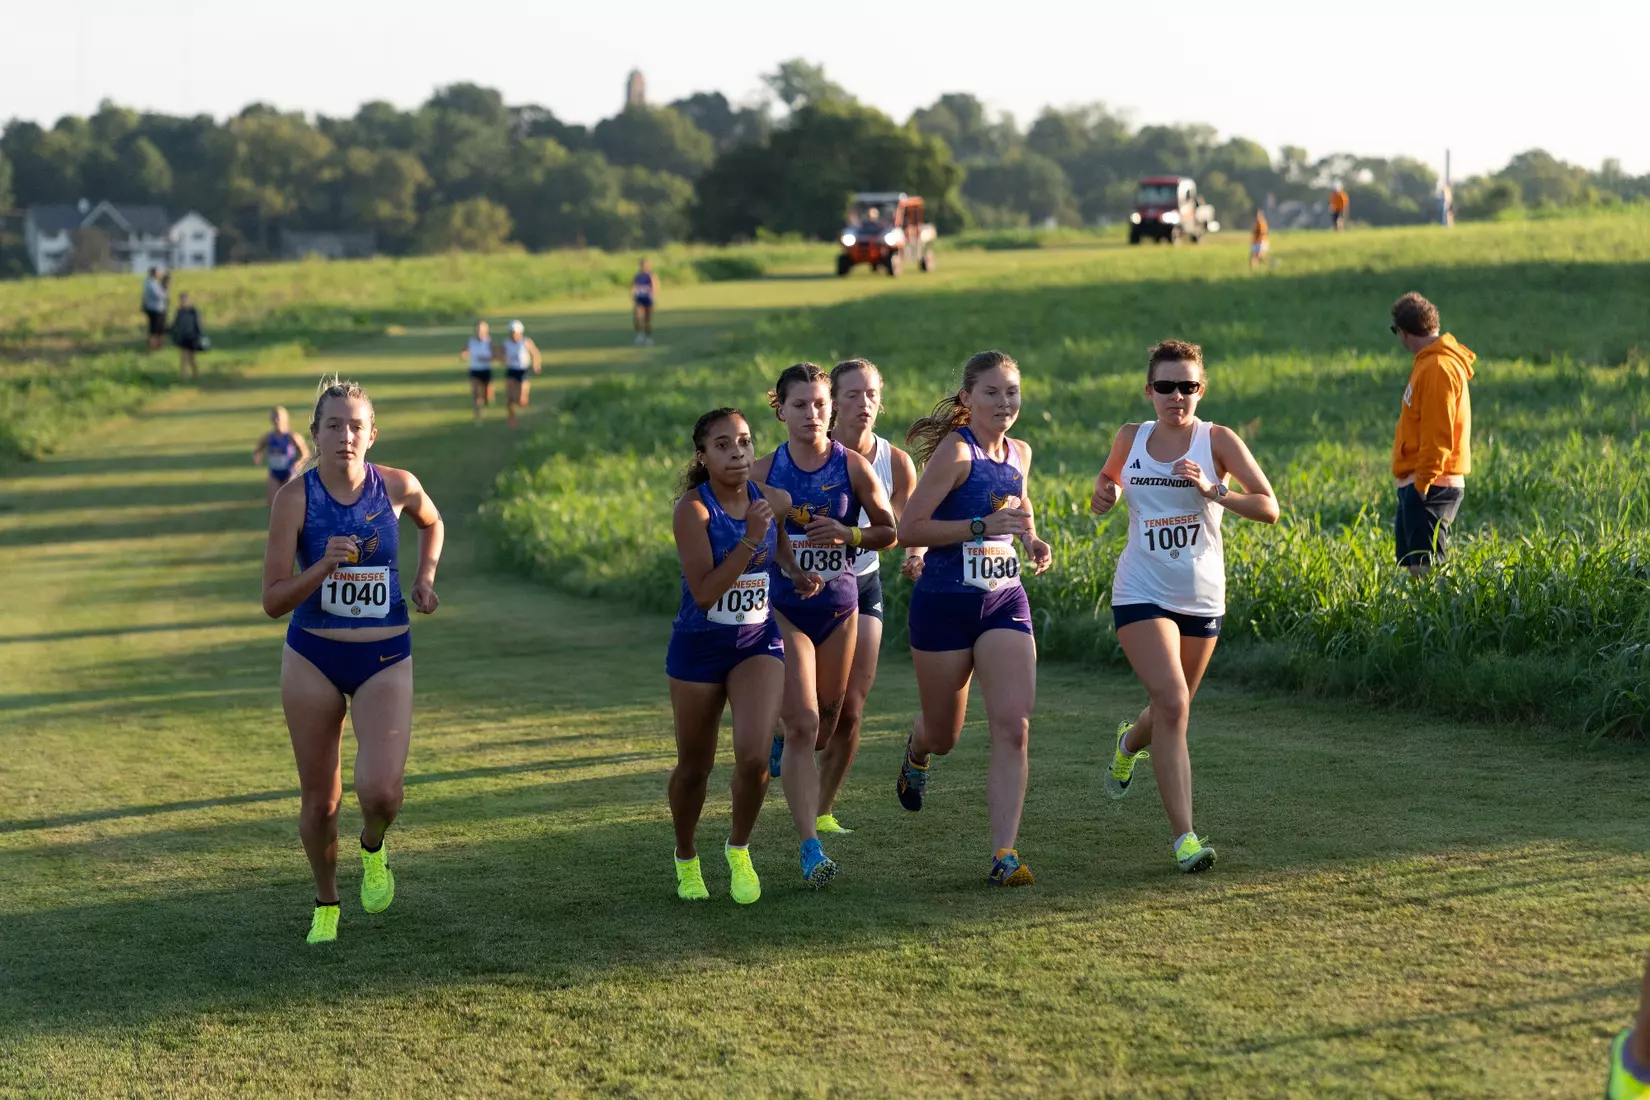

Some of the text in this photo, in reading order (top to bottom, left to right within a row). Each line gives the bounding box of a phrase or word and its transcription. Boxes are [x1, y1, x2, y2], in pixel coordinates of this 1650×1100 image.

[1130, 476, 1195, 488] CHATTANOO
[1143, 513, 1199, 528] TENNESSEE
[1144, 524, 1200, 551] 1007
[792, 549, 842, 571] 038
[967, 547, 1009, 556] TENNESS
[328, 571, 385, 581] TENNESSEE
[968, 556, 1017, 579] 1030
[733, 578, 766, 588] NESSEE
[327, 581, 387, 606] 1040
[717, 588, 766, 612] 1033
